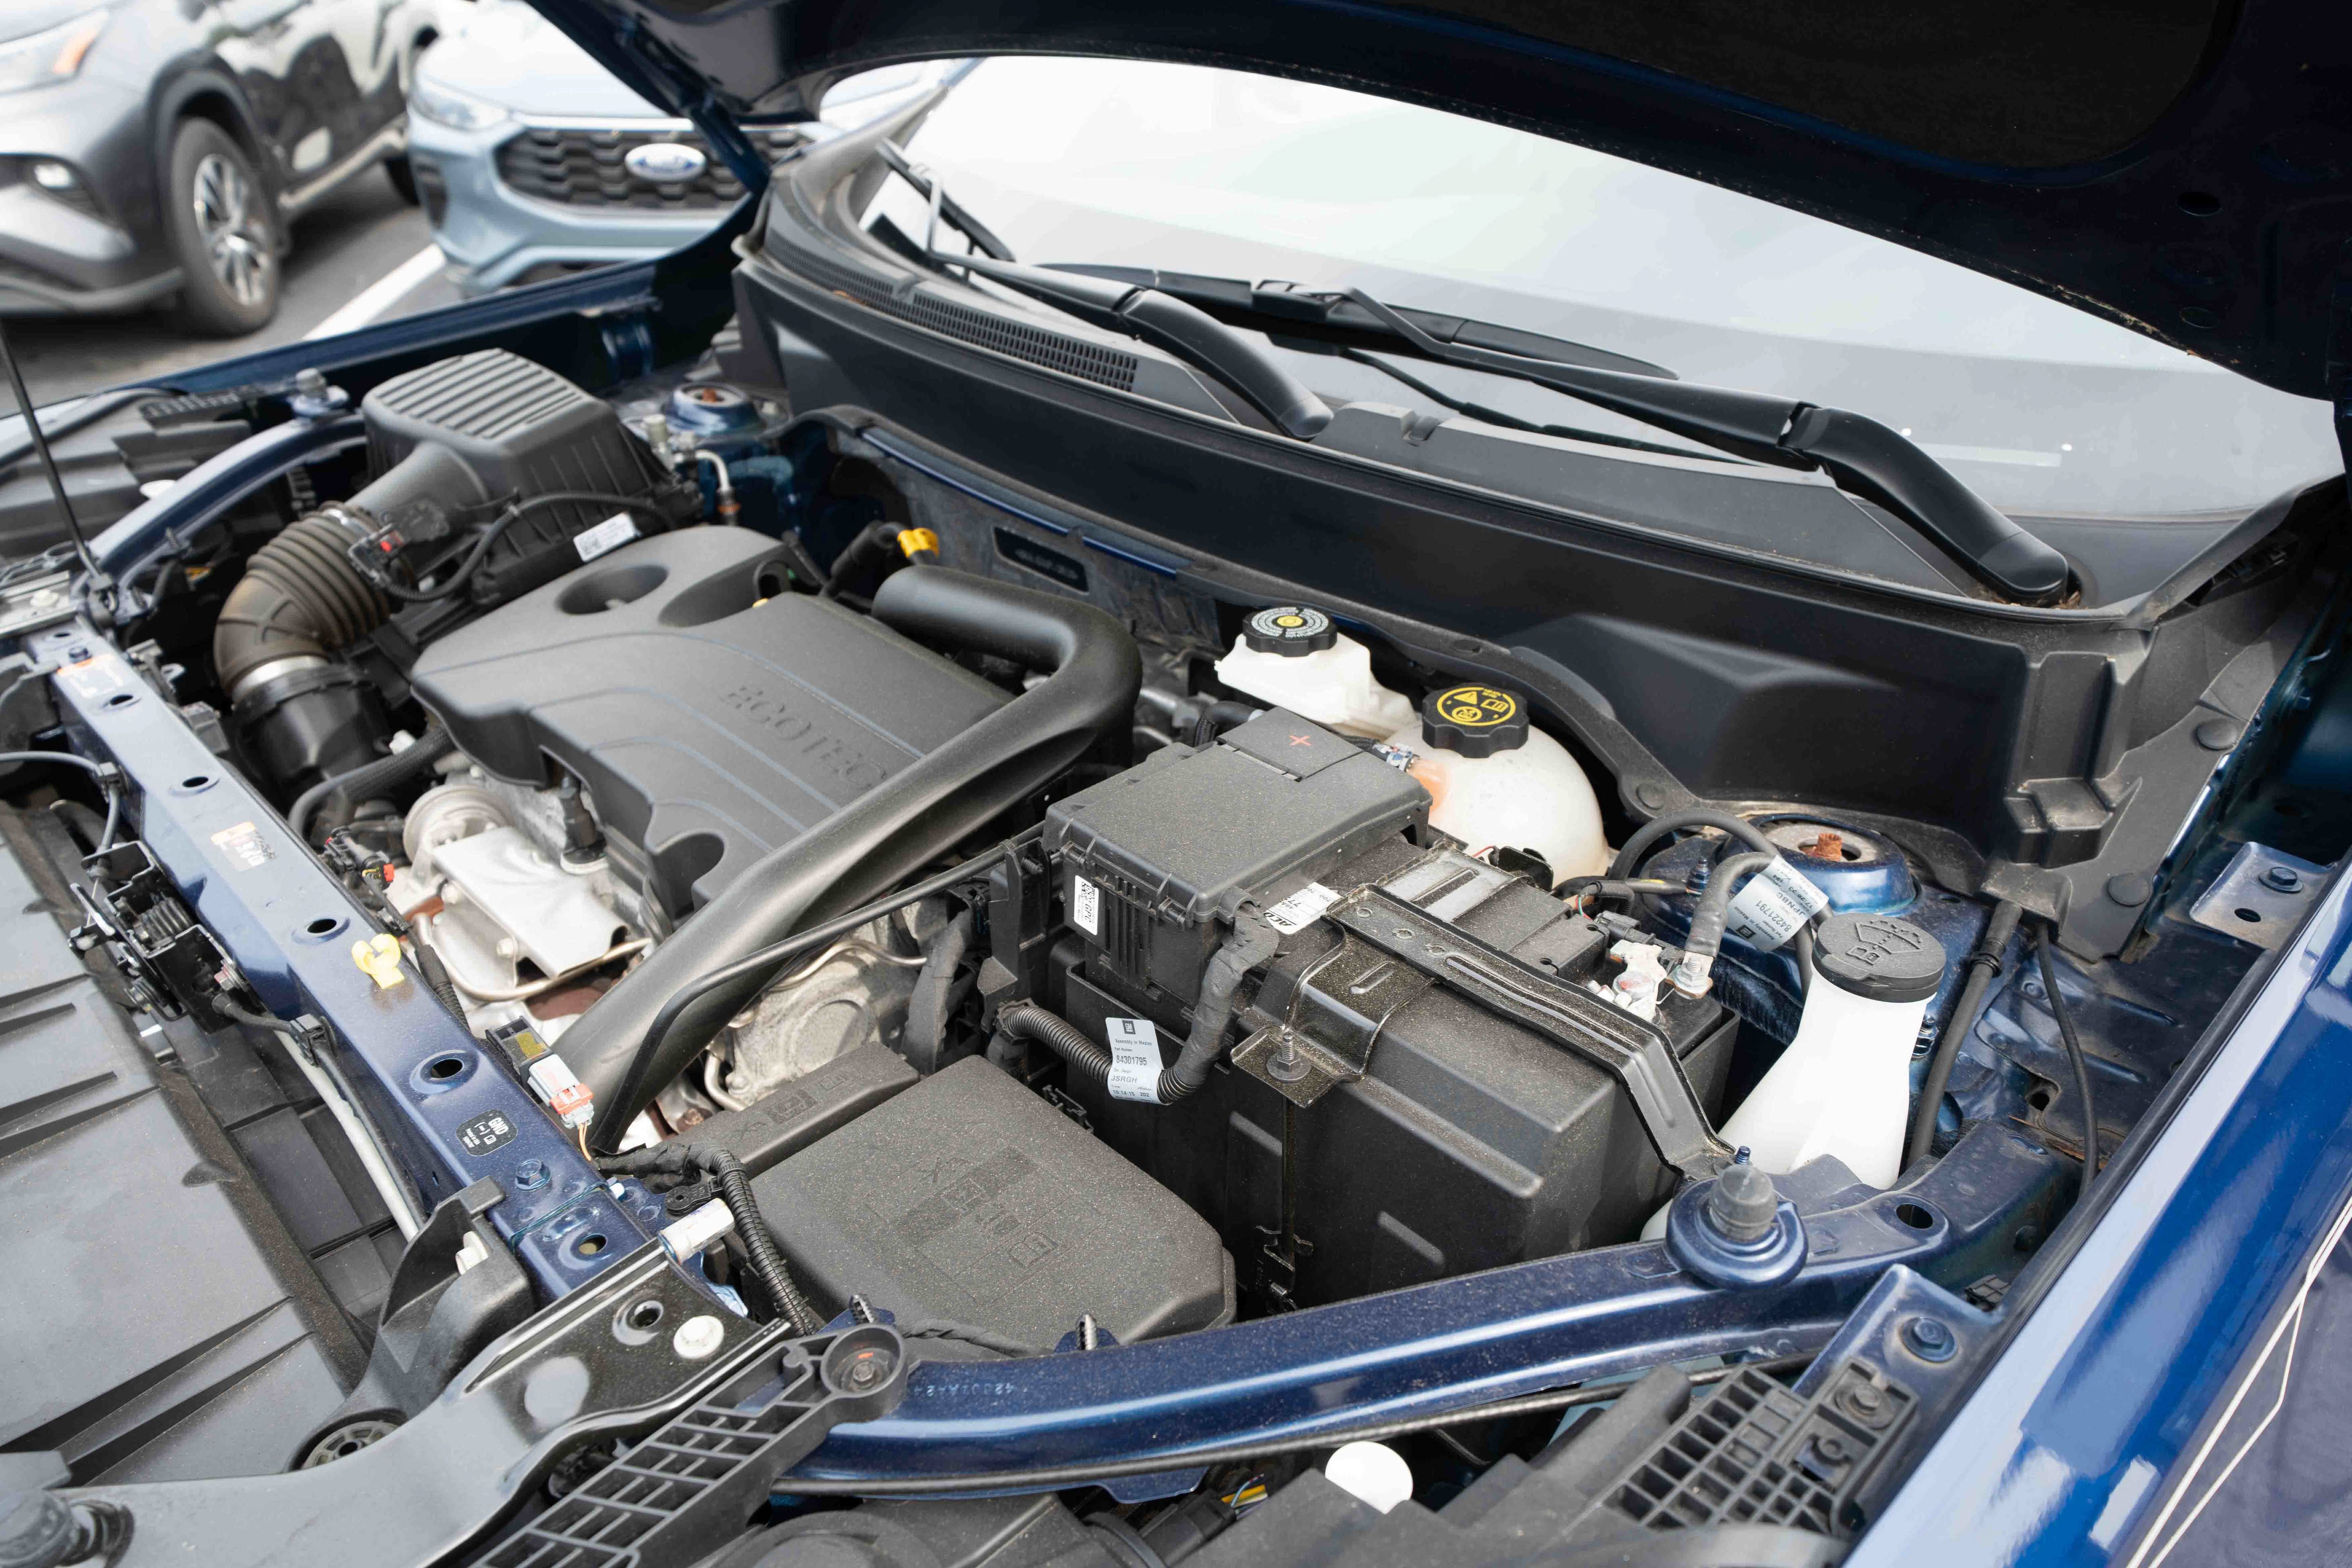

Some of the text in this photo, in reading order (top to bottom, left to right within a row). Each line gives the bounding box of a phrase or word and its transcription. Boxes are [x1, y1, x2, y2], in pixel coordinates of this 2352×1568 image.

[1773, 875, 1783, 883] 194
[1734, 906, 1750, 920] Mexico
[1776, 892, 1806, 916] JPNBC
[1755, 900, 1792, 932] 84221791
[1756, 922, 1775, 940] Assembly
[1116, 1055, 1147, 1065] 84301795
[488, 1117, 509, 1135] GND
